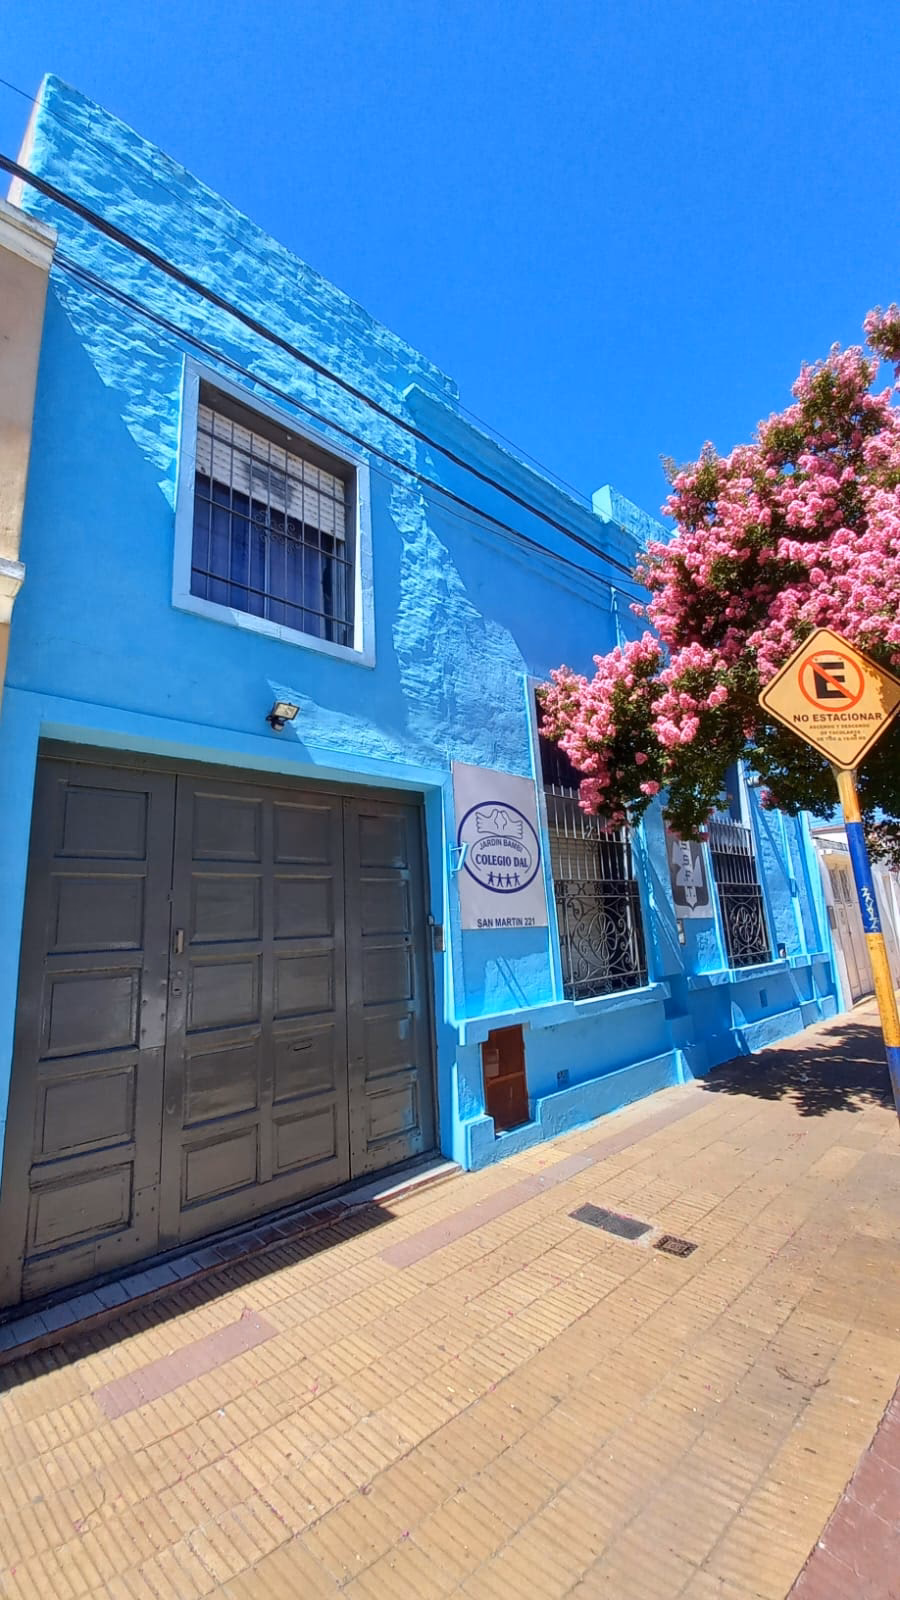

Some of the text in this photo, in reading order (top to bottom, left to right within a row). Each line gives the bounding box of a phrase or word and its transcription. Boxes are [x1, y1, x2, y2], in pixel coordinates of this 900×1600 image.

[793, 712, 883, 723] NO ESTACIONAR
[479, 838, 524, 853] JARDIN BAMBI
[475, 853, 529, 868] COLEGIO DAL
[477, 916, 536, 928] SAN MARTIN 221
